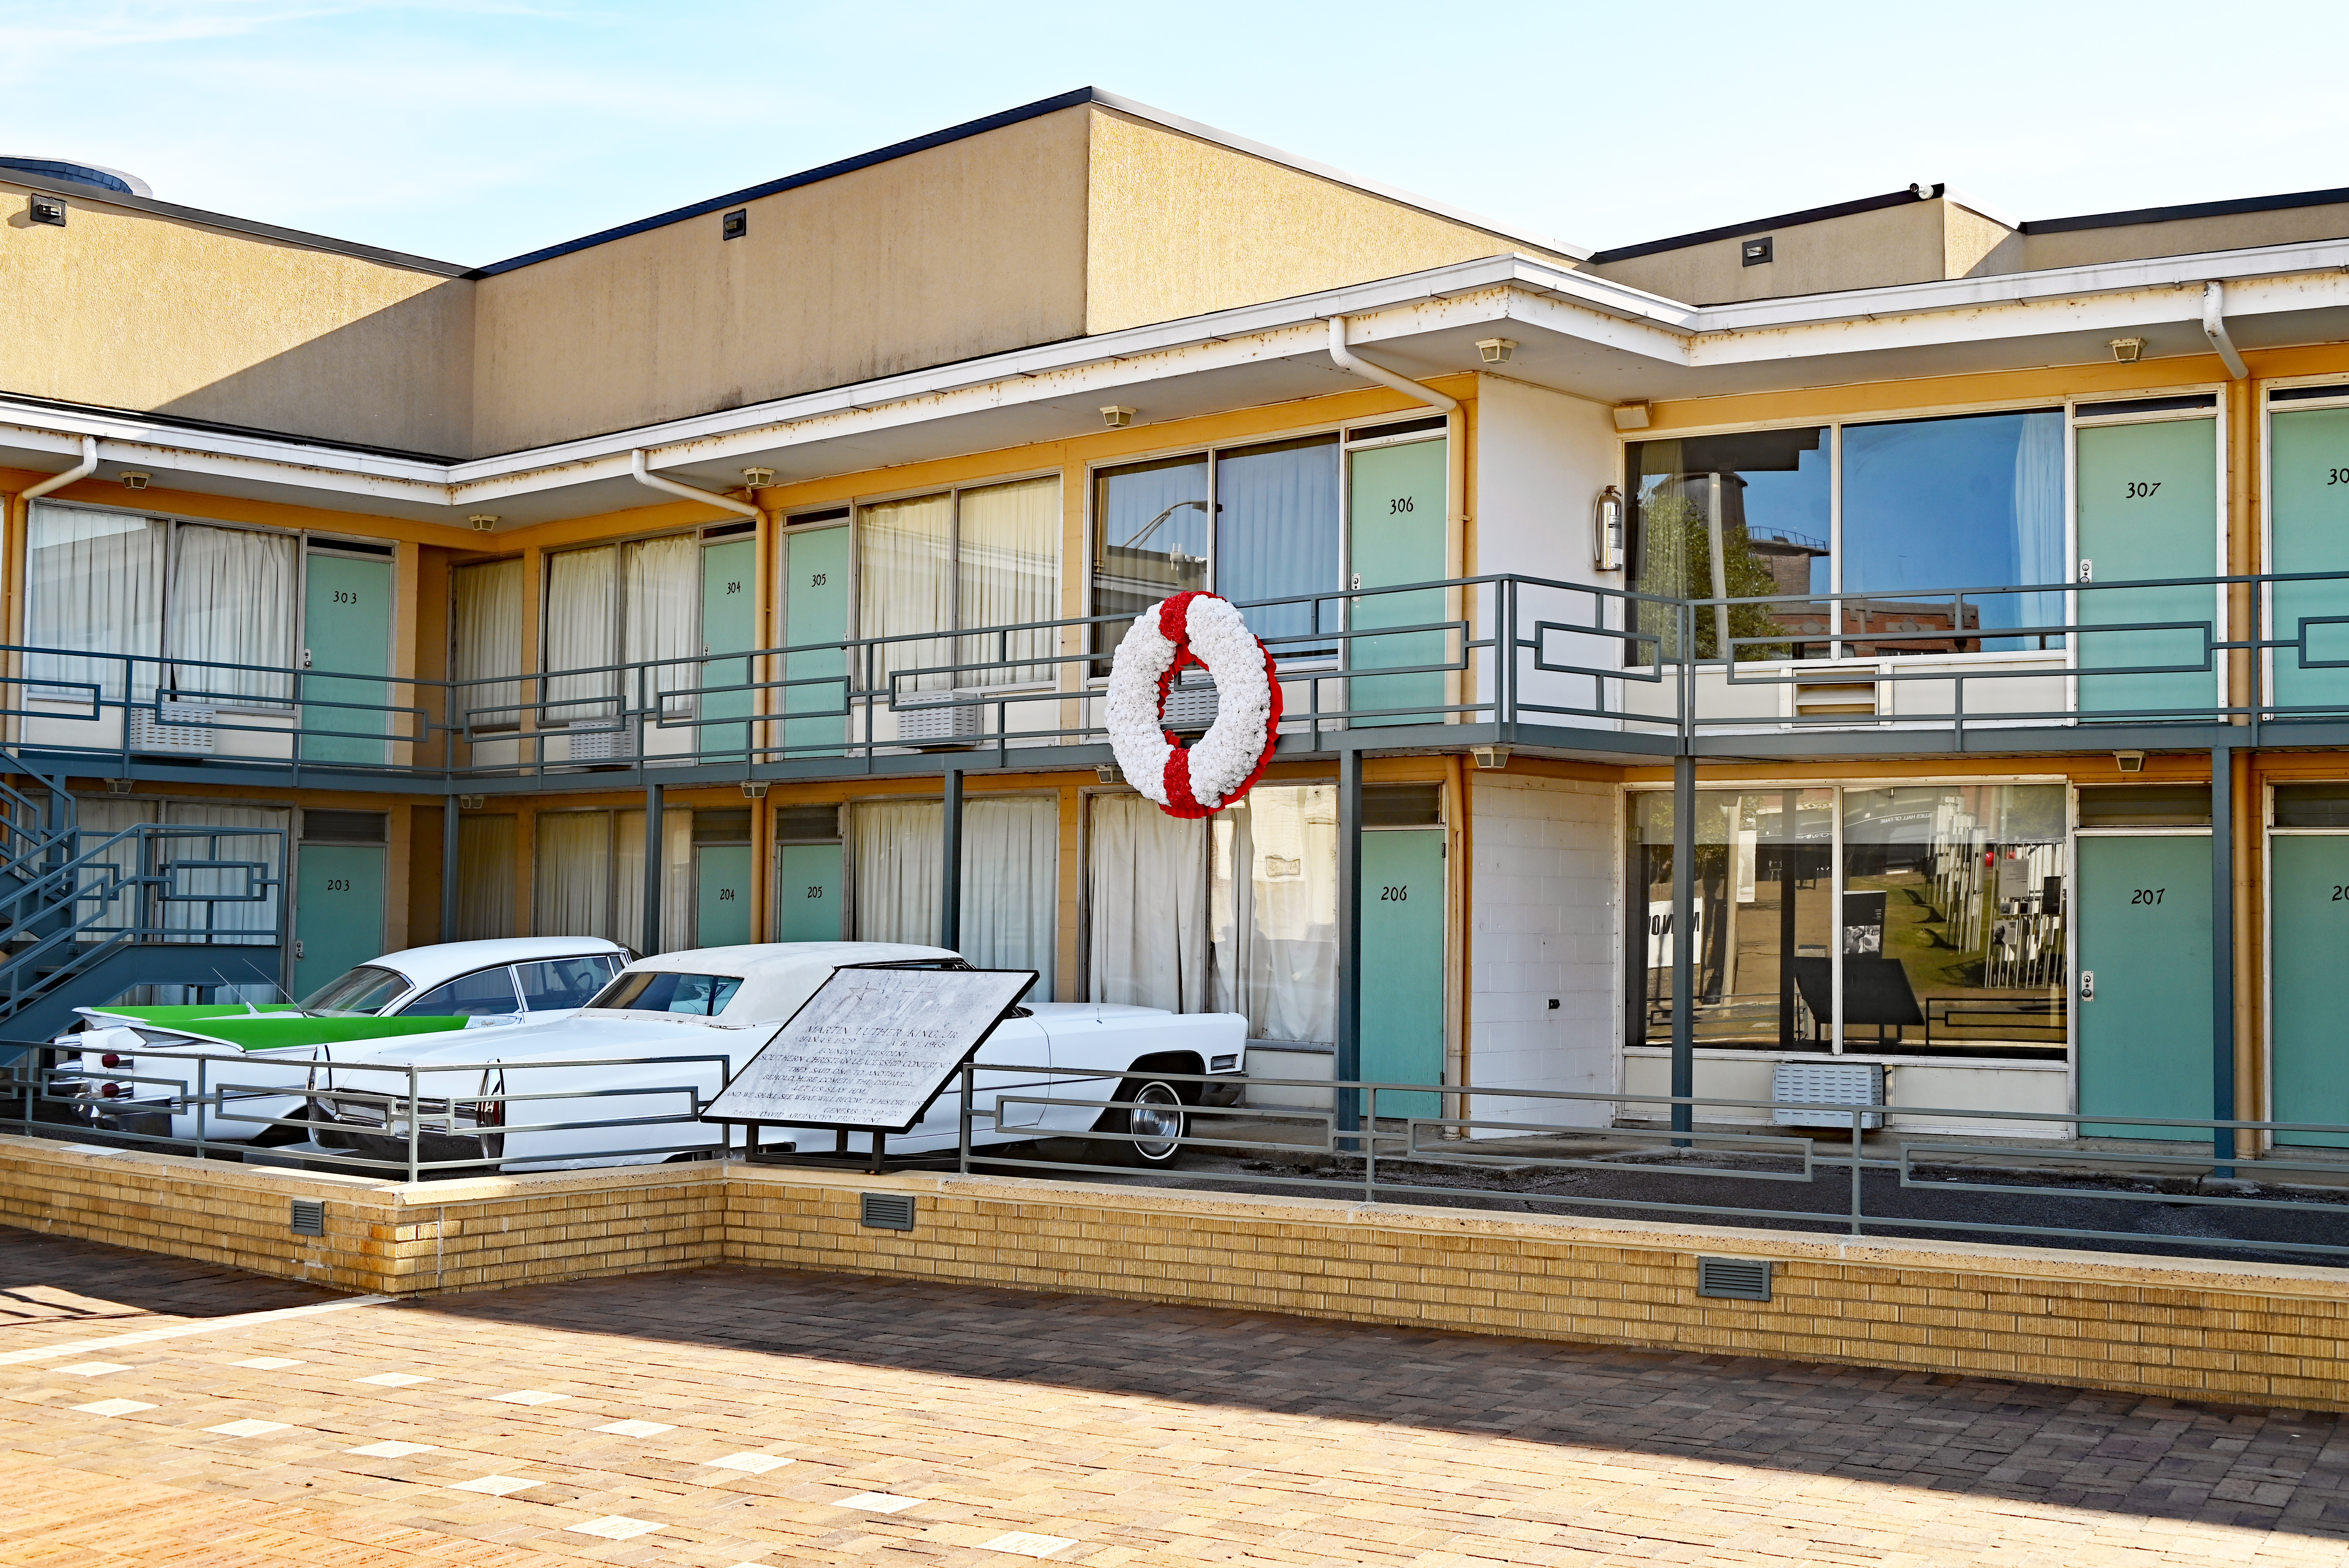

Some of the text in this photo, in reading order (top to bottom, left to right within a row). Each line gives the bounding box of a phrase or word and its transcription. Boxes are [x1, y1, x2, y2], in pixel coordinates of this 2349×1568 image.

[2126, 482, 2161, 499] 307
[1390, 496, 1413, 515] 306
[811, 574, 826, 587] 305
[726, 581, 740, 595] 304
[333, 591, 356, 604] 303
[327, 880, 349, 891] 203
[720, 889, 734, 902] 204
[807, 886, 822, 899] 205
[1381, 885, 1407, 902] 206
[2131, 888, 2165, 905] 207
[805, 1025, 851, 1034] MARTIN
[855, 1028, 902, 1037] LUTHER
[942, 1030, 958, 1039] JR.
[758, 1054, 806, 1062] SOUTHERN
[806, 1056, 851, 1064] CHRISTIAN
[851, 1058, 901, 1067] LEADERSHIP
[836, 1115, 882, 1123] PRESIDENT
